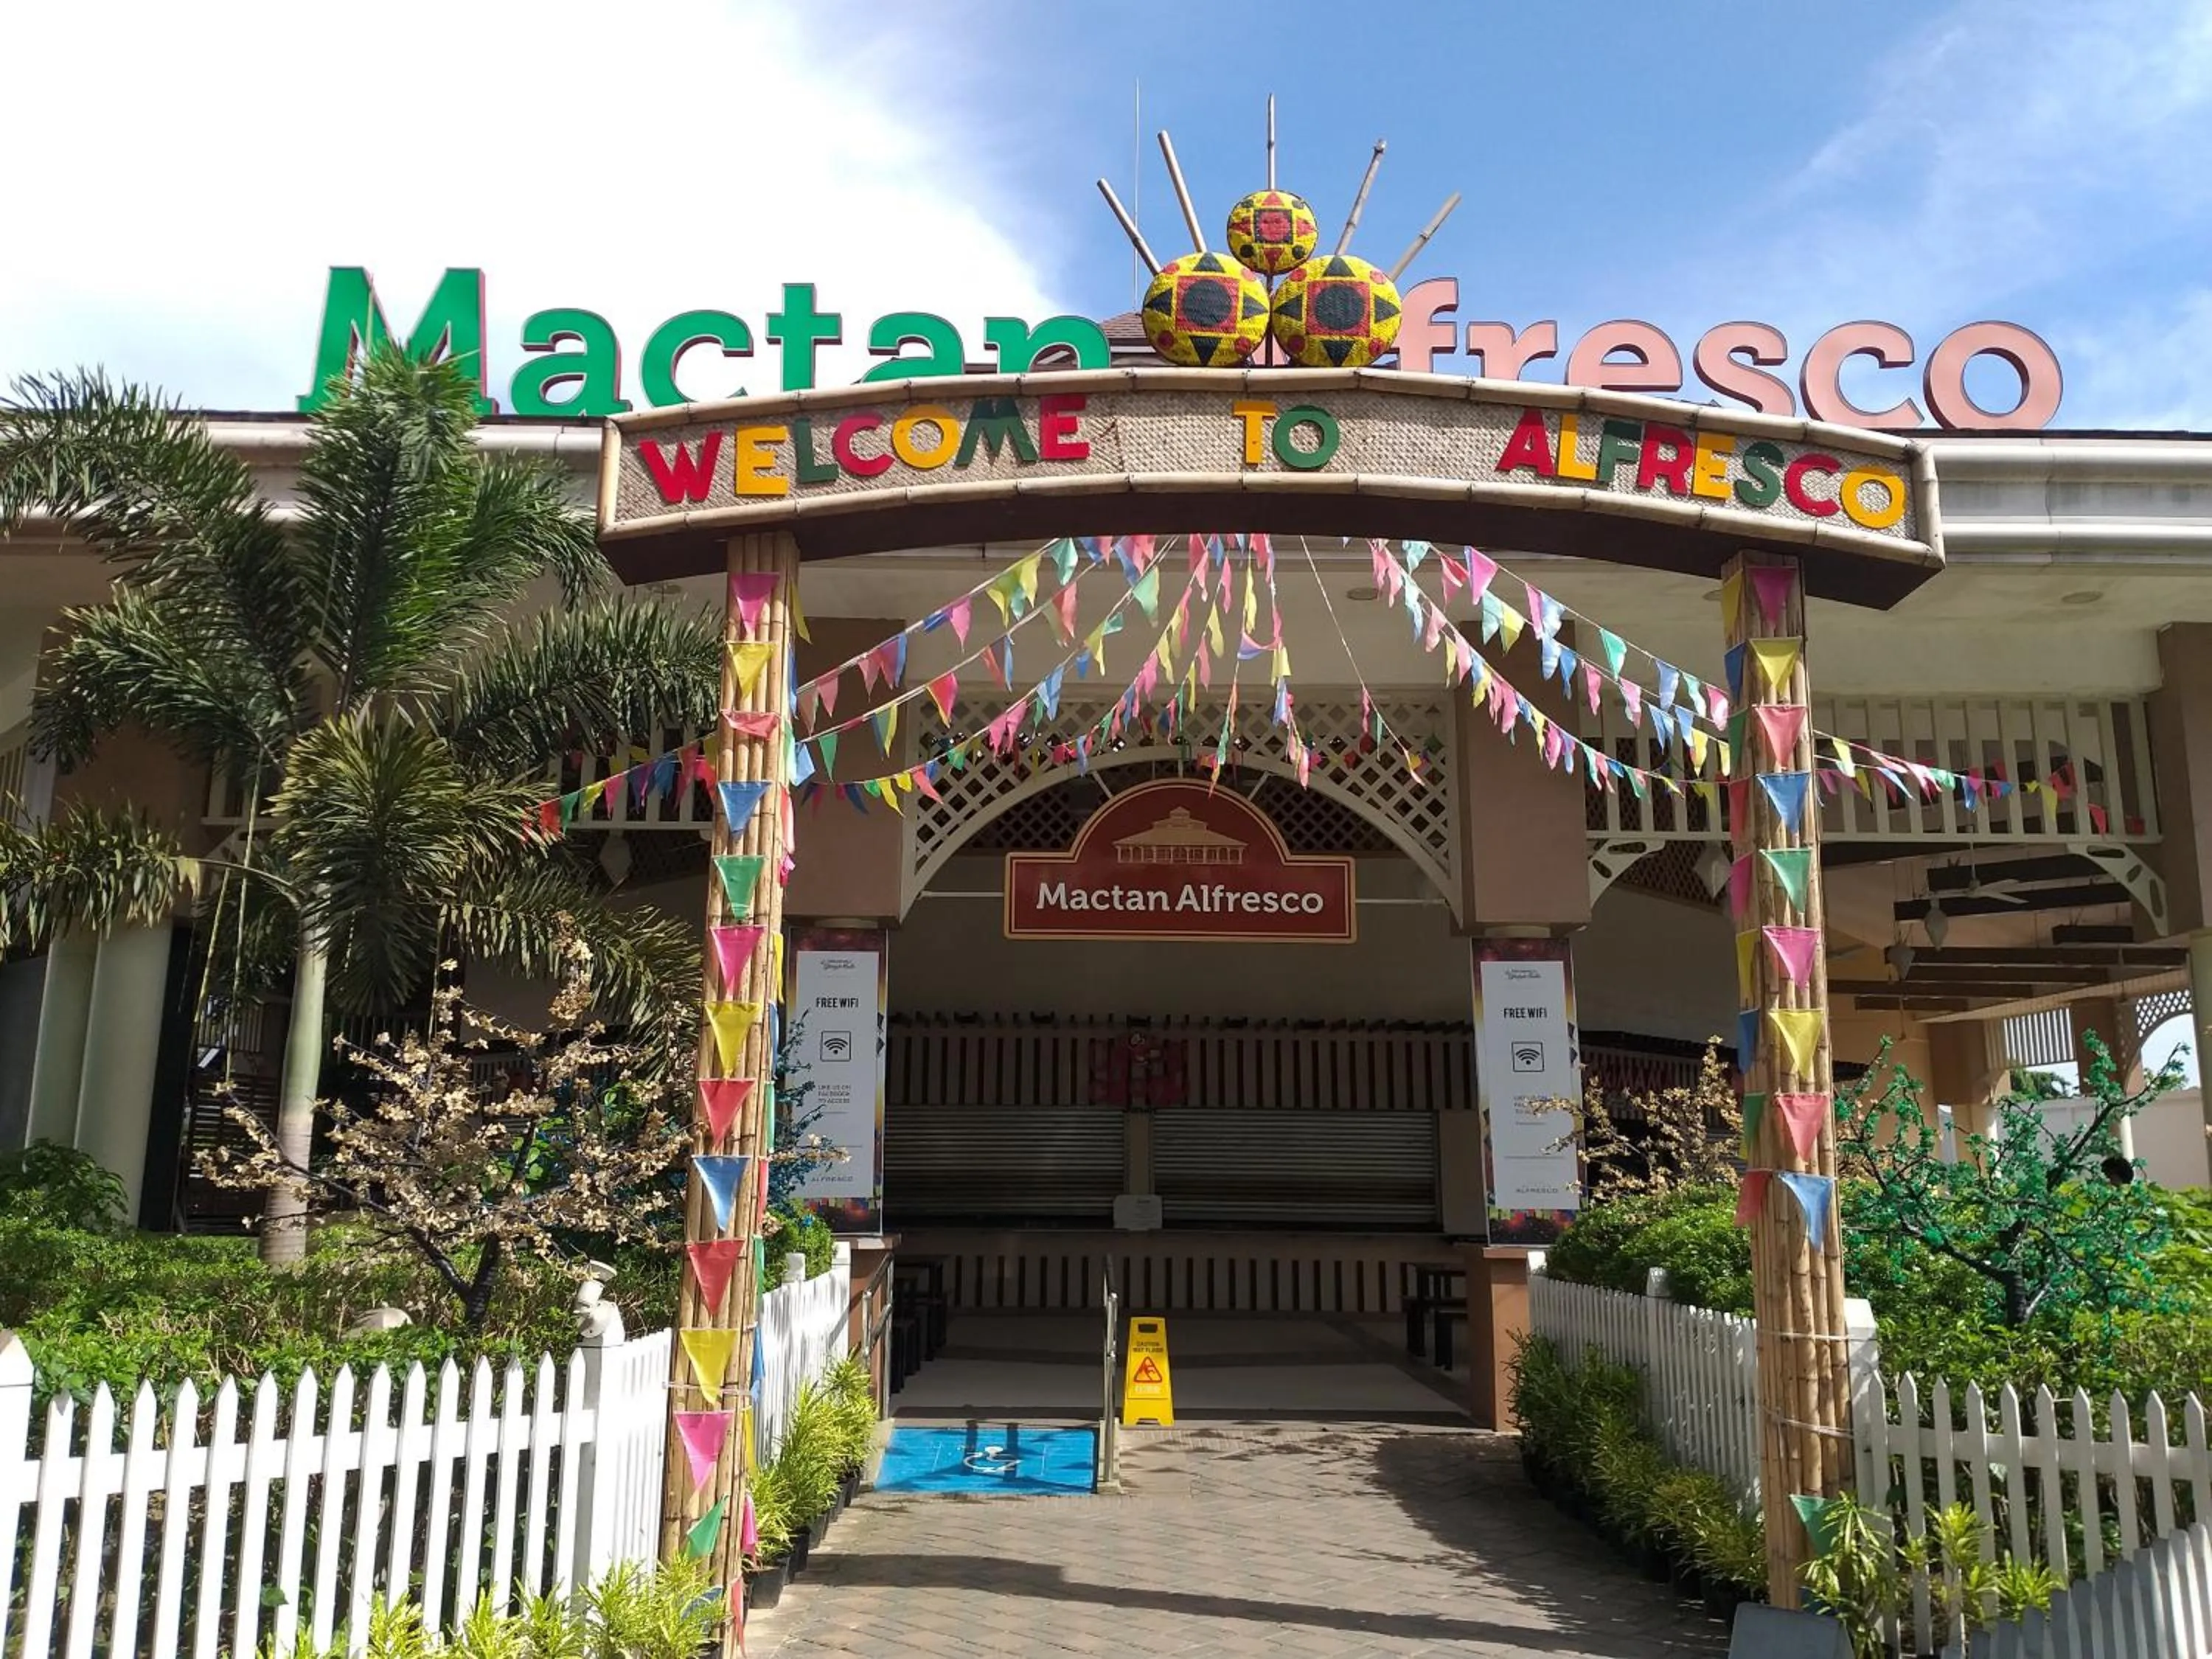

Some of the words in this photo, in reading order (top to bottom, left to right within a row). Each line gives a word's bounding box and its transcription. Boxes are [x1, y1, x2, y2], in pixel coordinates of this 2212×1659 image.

[296, 266, 1112, 416] Mactan
[1249, 277, 2064, 432] fresco
[639, 394, 1090, 503] WELCOME
[1234, 400, 1339, 470] TO
[1497, 409, 1906, 529] ALFRESCO
[1037, 883, 1169, 911] Mactan
[1175, 885, 1324, 914] Alfresco
[816, 997, 838, 1008] FREE
[840, 997, 859, 1008] WIFI
[1503, 1007, 1525, 1018] FREE
[1527, 1007, 1548, 1018] WIFI
